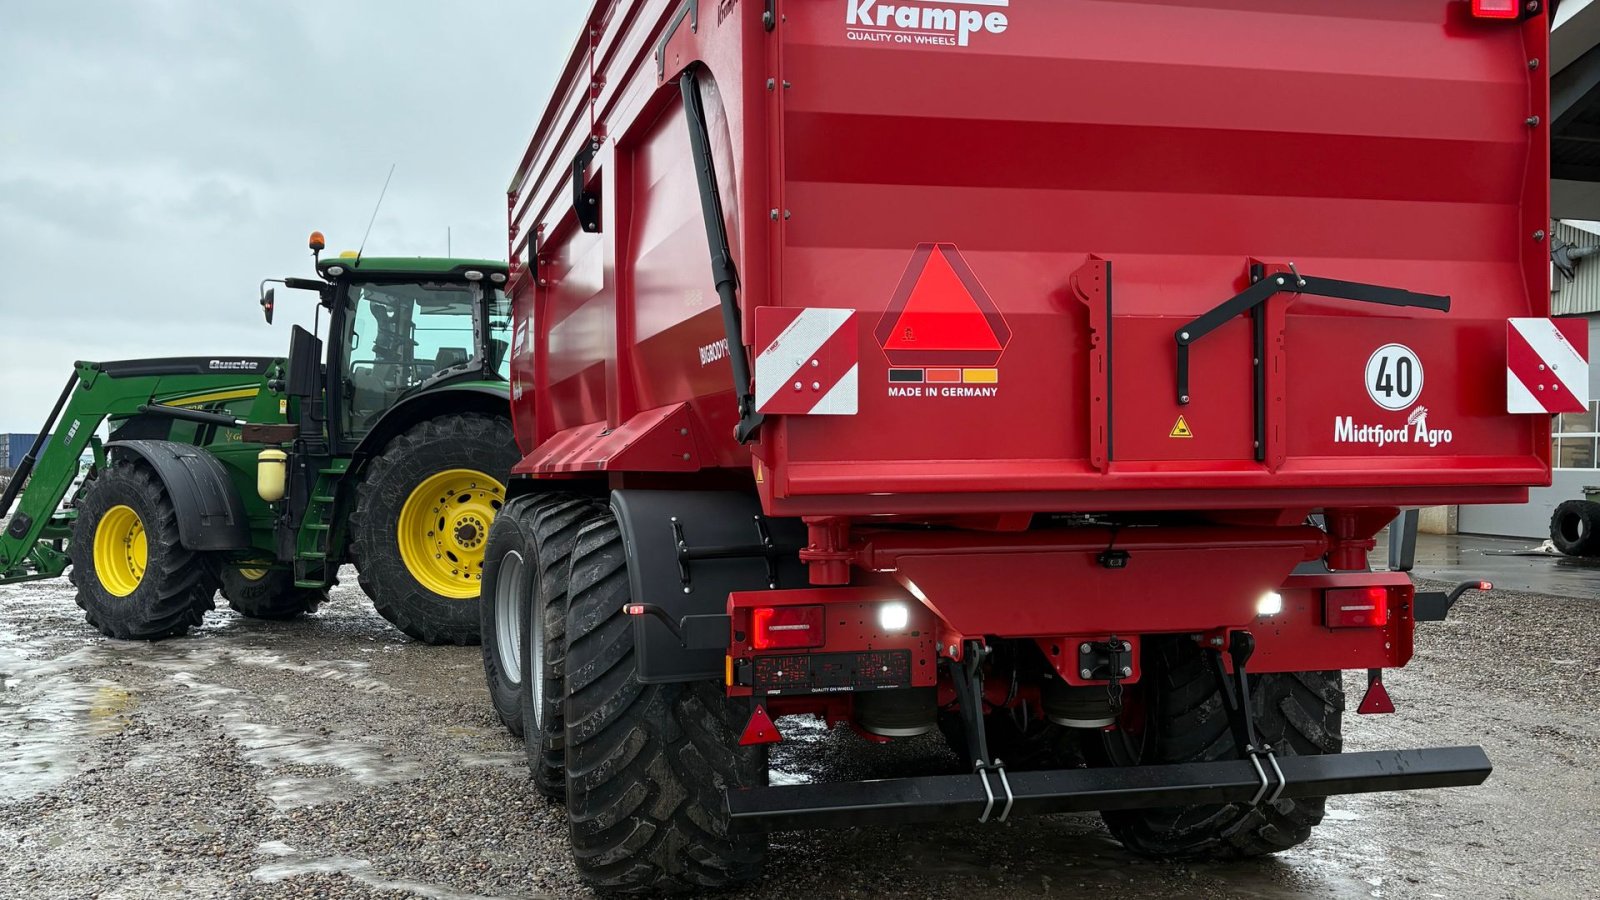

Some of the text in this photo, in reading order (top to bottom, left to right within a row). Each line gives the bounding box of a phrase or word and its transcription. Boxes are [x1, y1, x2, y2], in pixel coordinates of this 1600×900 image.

[846, 0, 1009, 47] Krampe
[847, 31, 956, 46] QUALITY ON WHEELS
[209, 360, 258, 369] Quicke
[1375, 356, 1412, 398] 40
[888, 387, 998, 397] MADE IN GERMANY
[1334, 416, 1453, 448] Midtfjord Agro
